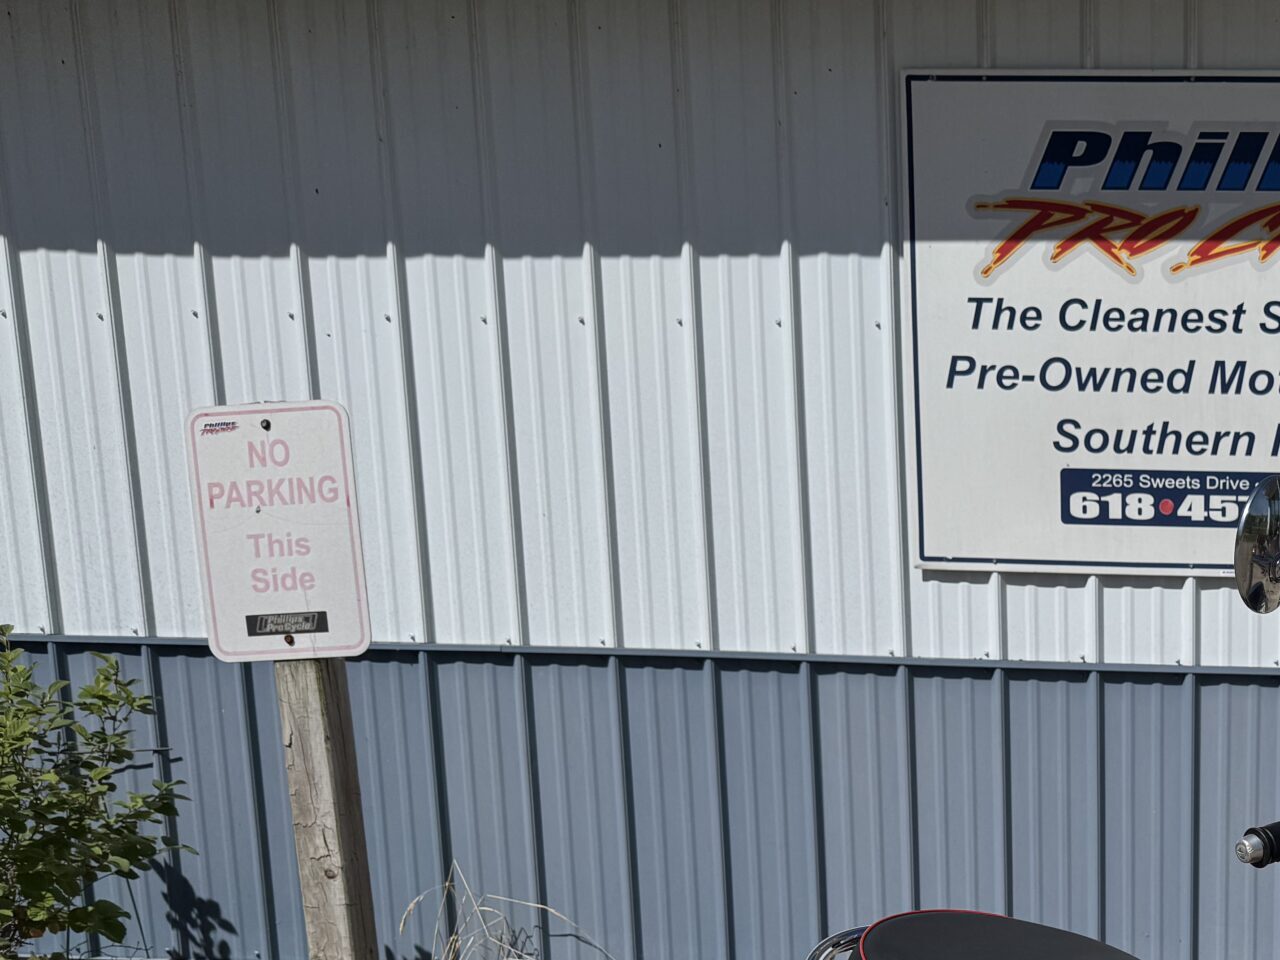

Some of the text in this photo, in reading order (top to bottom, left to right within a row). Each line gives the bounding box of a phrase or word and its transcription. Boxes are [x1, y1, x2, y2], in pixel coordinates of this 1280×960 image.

[976, 199, 1199, 278] PRO
[967, 297, 1042, 331] The
[1058, 298, 1247, 333] Cleanest
[946, 355, 1196, 394] Pre-Owned
[247, 439, 289, 467] NO
[1053, 418, 1256, 456] Southern
[207, 475, 339, 509] PARKING
[1091, 473, 1134, 488] 2265
[1138, 474, 1201, 489] Sweets
[1206, 475, 1250, 491] Drive
[247, 533, 311, 558] This
[250, 567, 316, 593] Side
